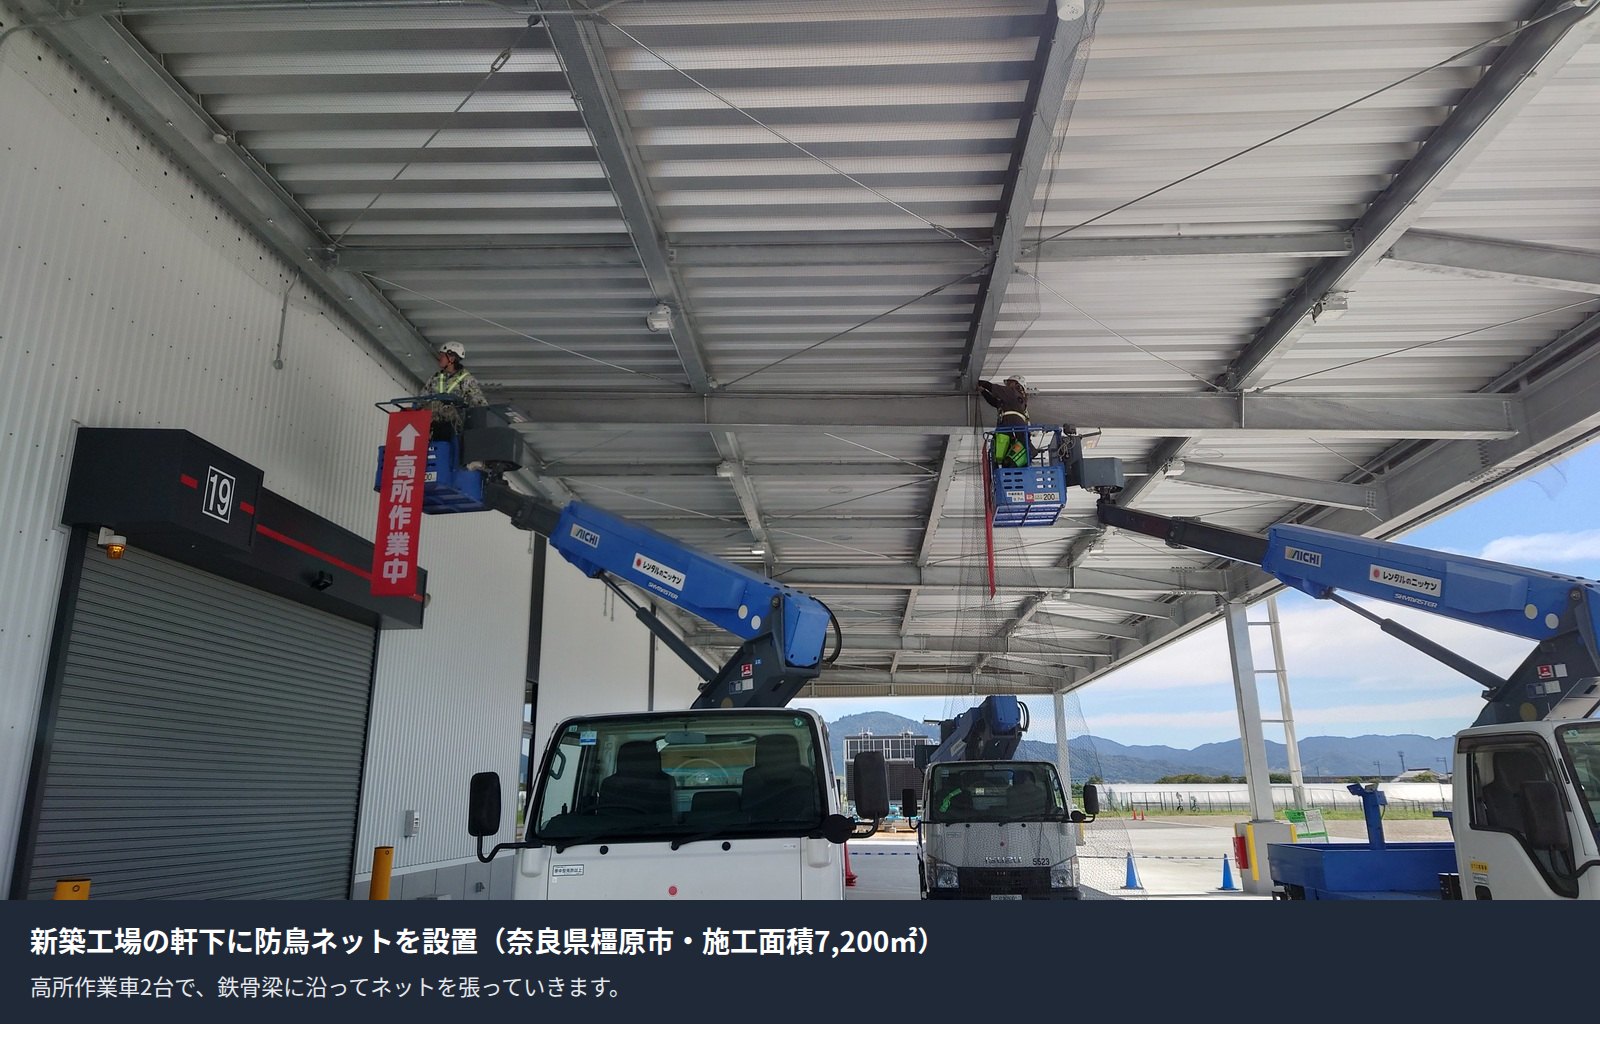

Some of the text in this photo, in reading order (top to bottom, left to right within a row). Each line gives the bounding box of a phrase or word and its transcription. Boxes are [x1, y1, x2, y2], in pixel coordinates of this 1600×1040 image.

[208, 474, 231, 516] 19
[383, 454, 418, 584] 高所作業中
[574, 528, 599, 546] AICHI
[1289, 549, 1320, 566] AICHI
[642, 561, 682, 585] レンタルのニッケン
[1383, 571, 1438, 591] レンタルのニッケン
[1394, 593, 1438, 608] SKYMASTER
[1032, 858, 1050, 866] 5523
